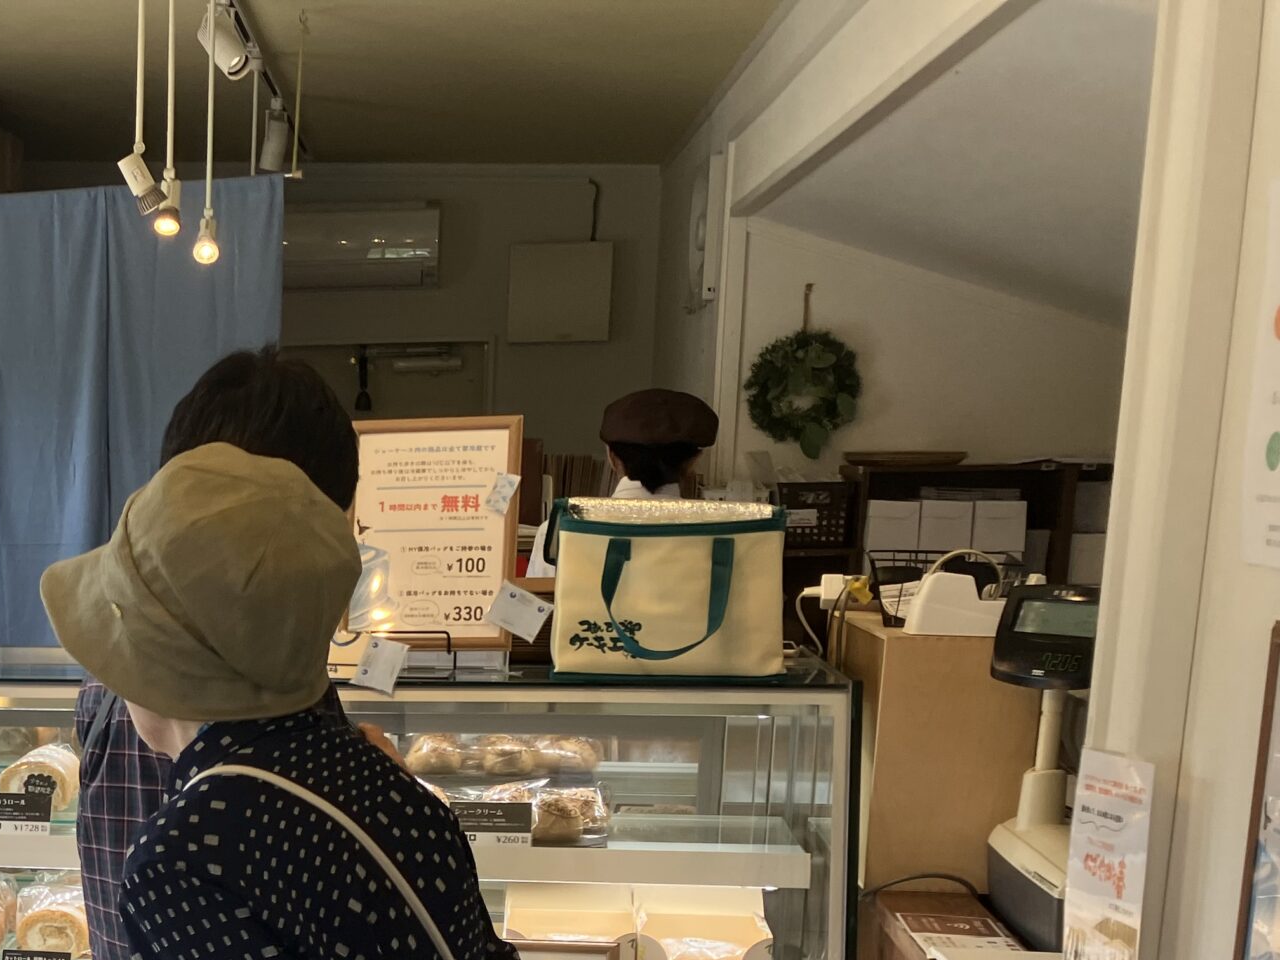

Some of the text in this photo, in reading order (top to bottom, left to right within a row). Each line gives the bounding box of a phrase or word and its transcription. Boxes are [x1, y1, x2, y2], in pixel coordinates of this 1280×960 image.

[441, 494, 481, 513] 無料
[454, 808, 503, 816] シュークリーム
[14, 824, 40, 832] ¥1728
[496, 836, 520, 844] ¥260
